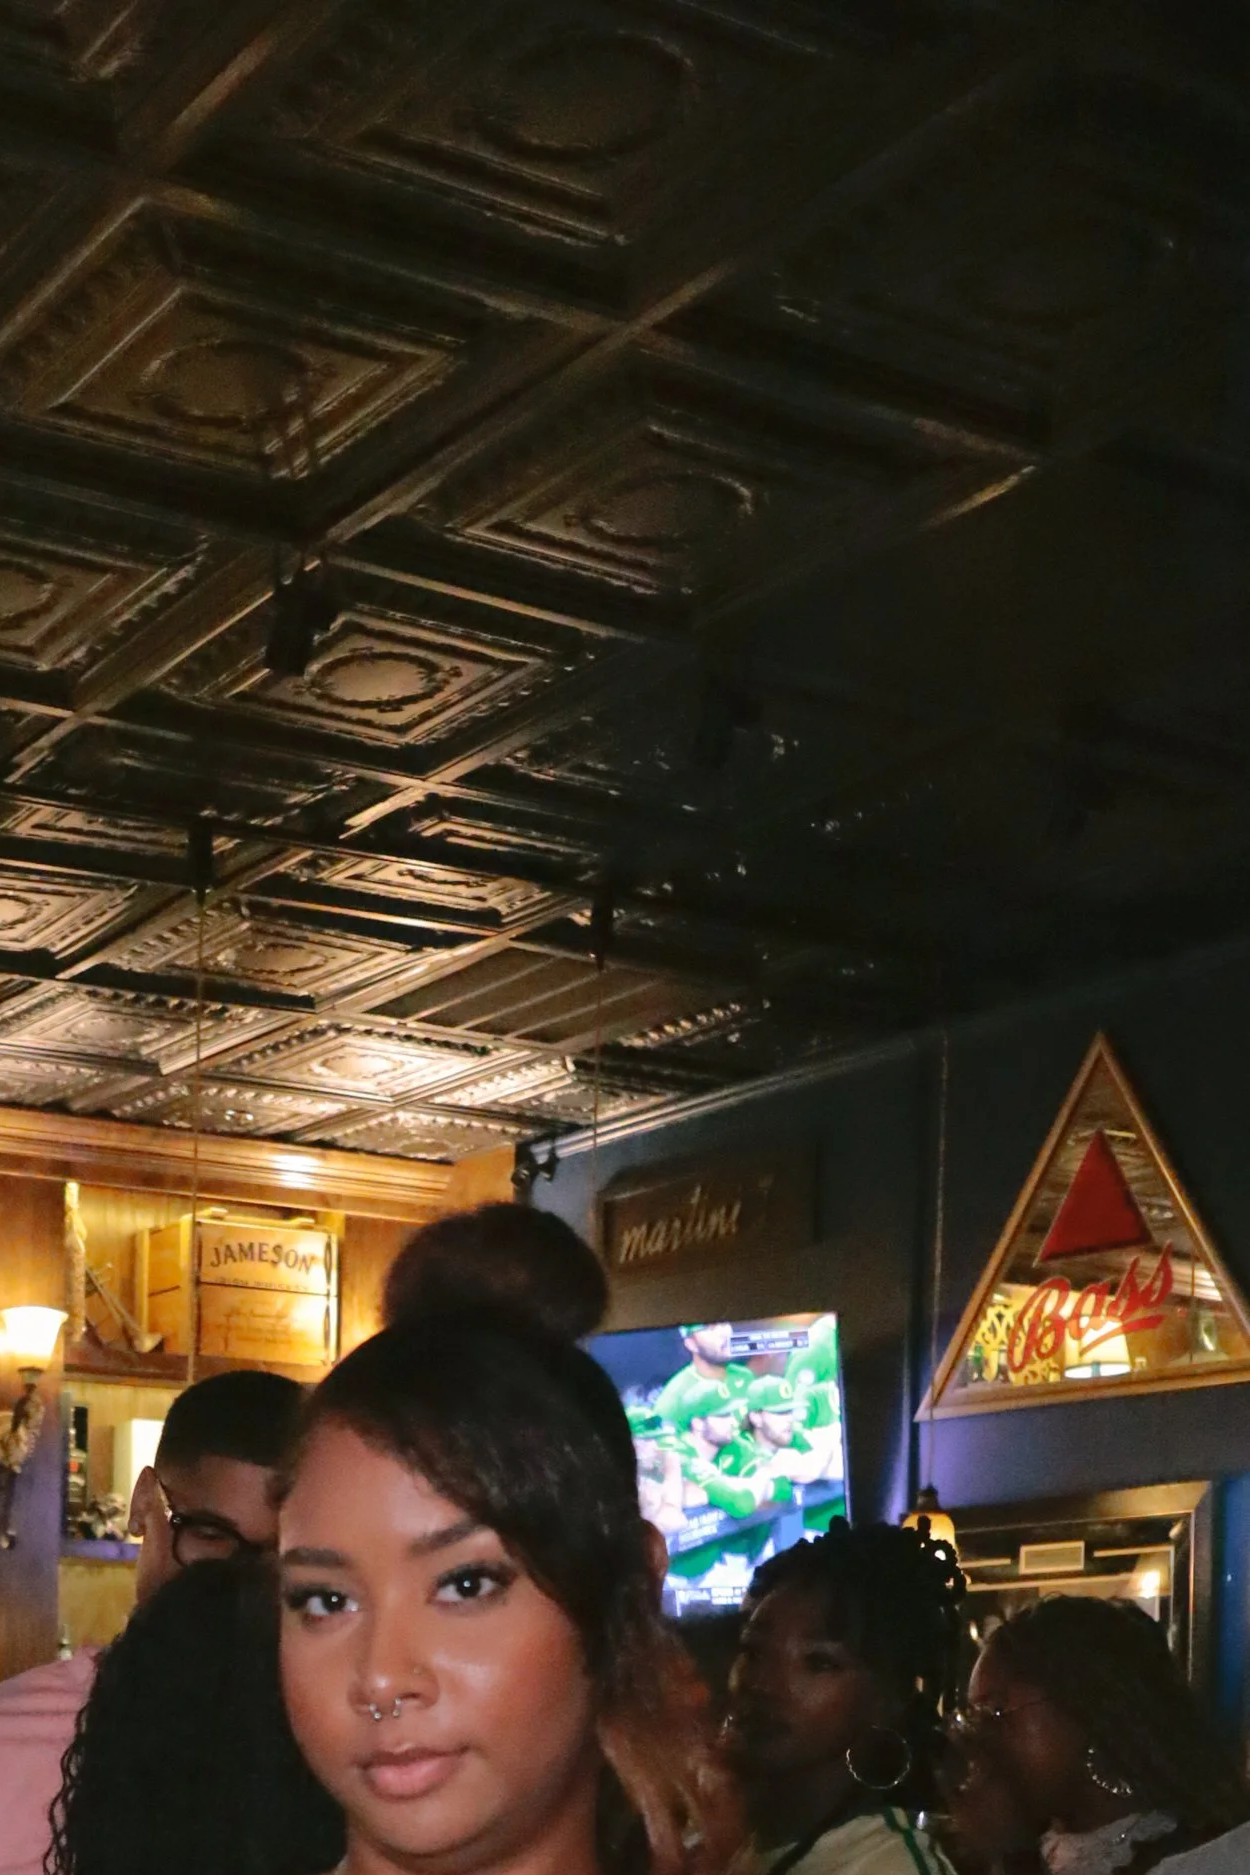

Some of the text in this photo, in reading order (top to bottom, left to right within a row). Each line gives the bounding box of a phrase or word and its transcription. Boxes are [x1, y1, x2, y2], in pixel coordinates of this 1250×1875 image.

[209, 1240, 313, 1275] JAMESON
[618, 1184, 742, 1264] martini
[1006, 1239, 1174, 1374] Bass
